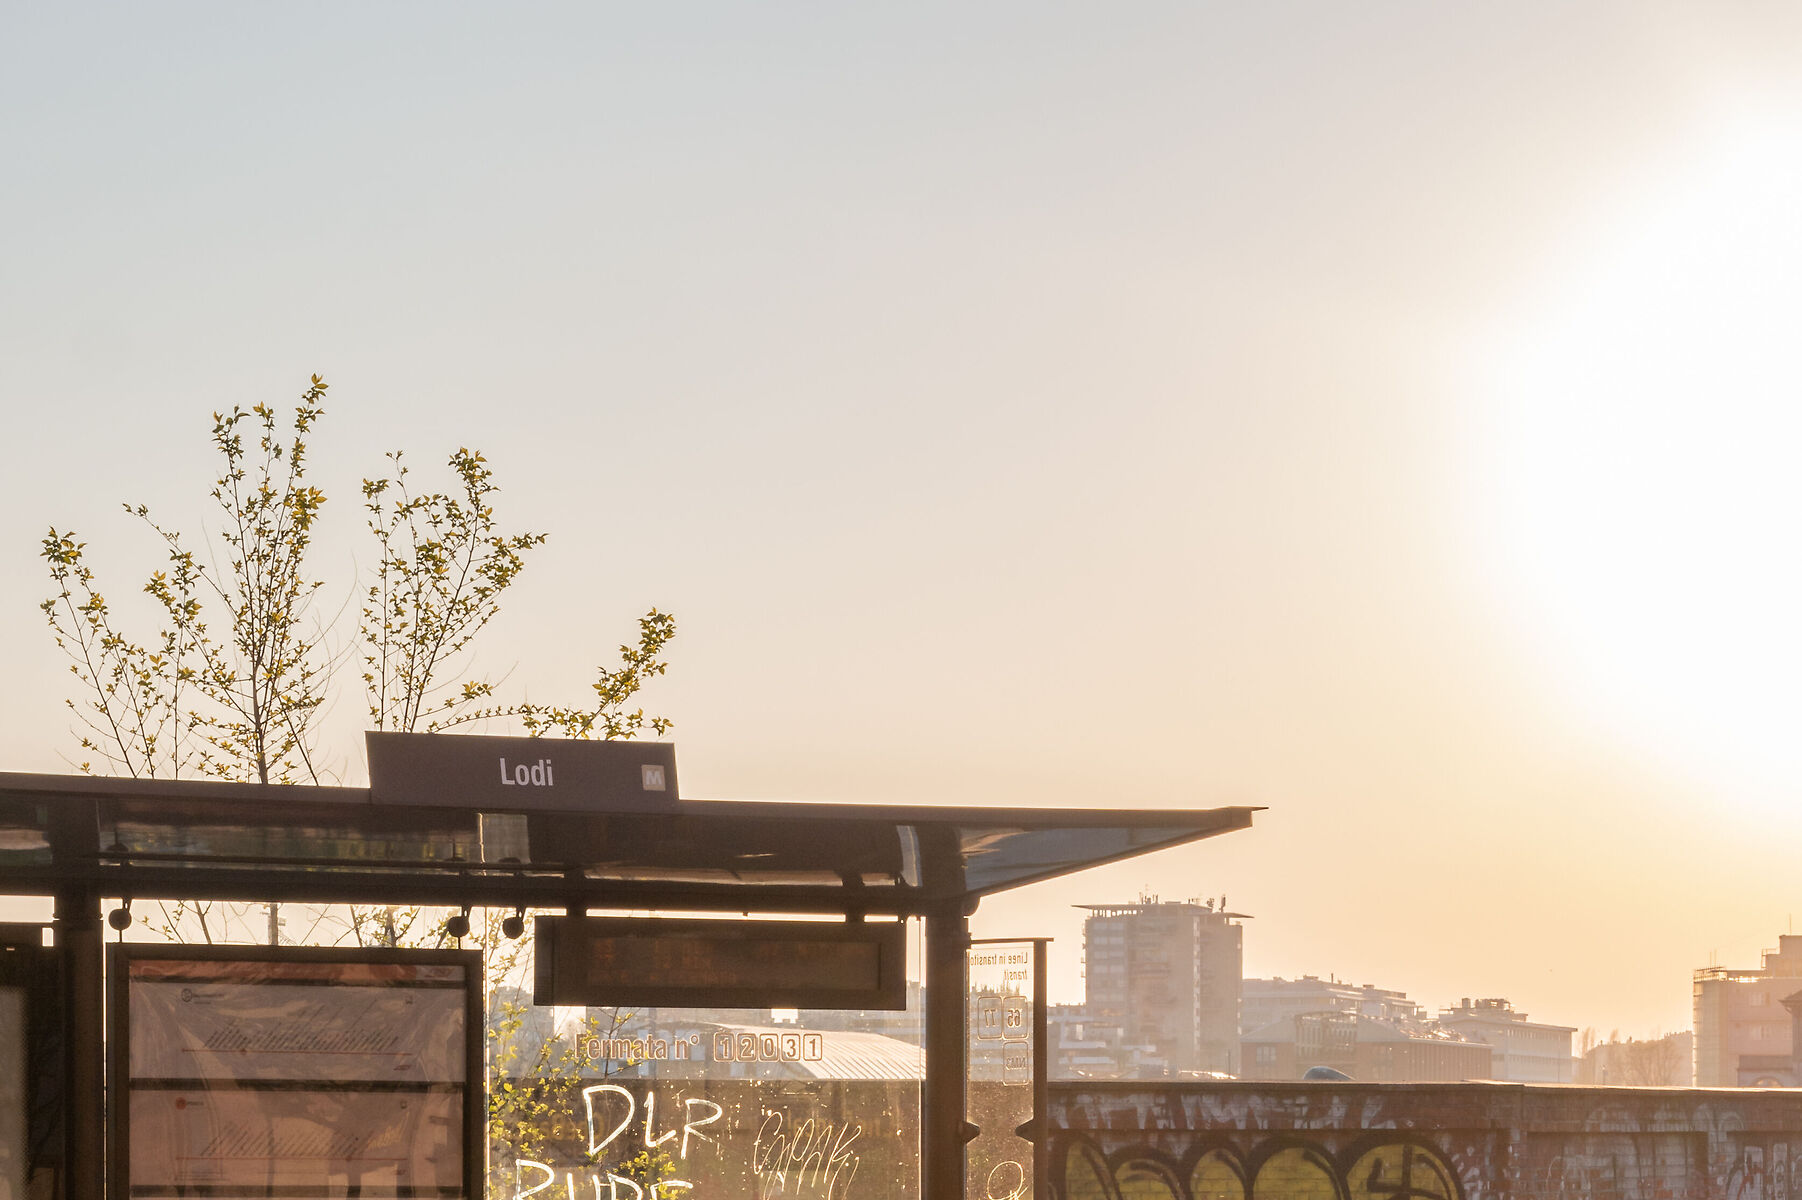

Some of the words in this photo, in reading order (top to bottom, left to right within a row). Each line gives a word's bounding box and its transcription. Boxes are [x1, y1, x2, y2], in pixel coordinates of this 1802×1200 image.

[499, 757, 554, 786] Lodi
[574, 1033, 669, 1060] Fermata
[718, 1036, 819, 1059] 12031
